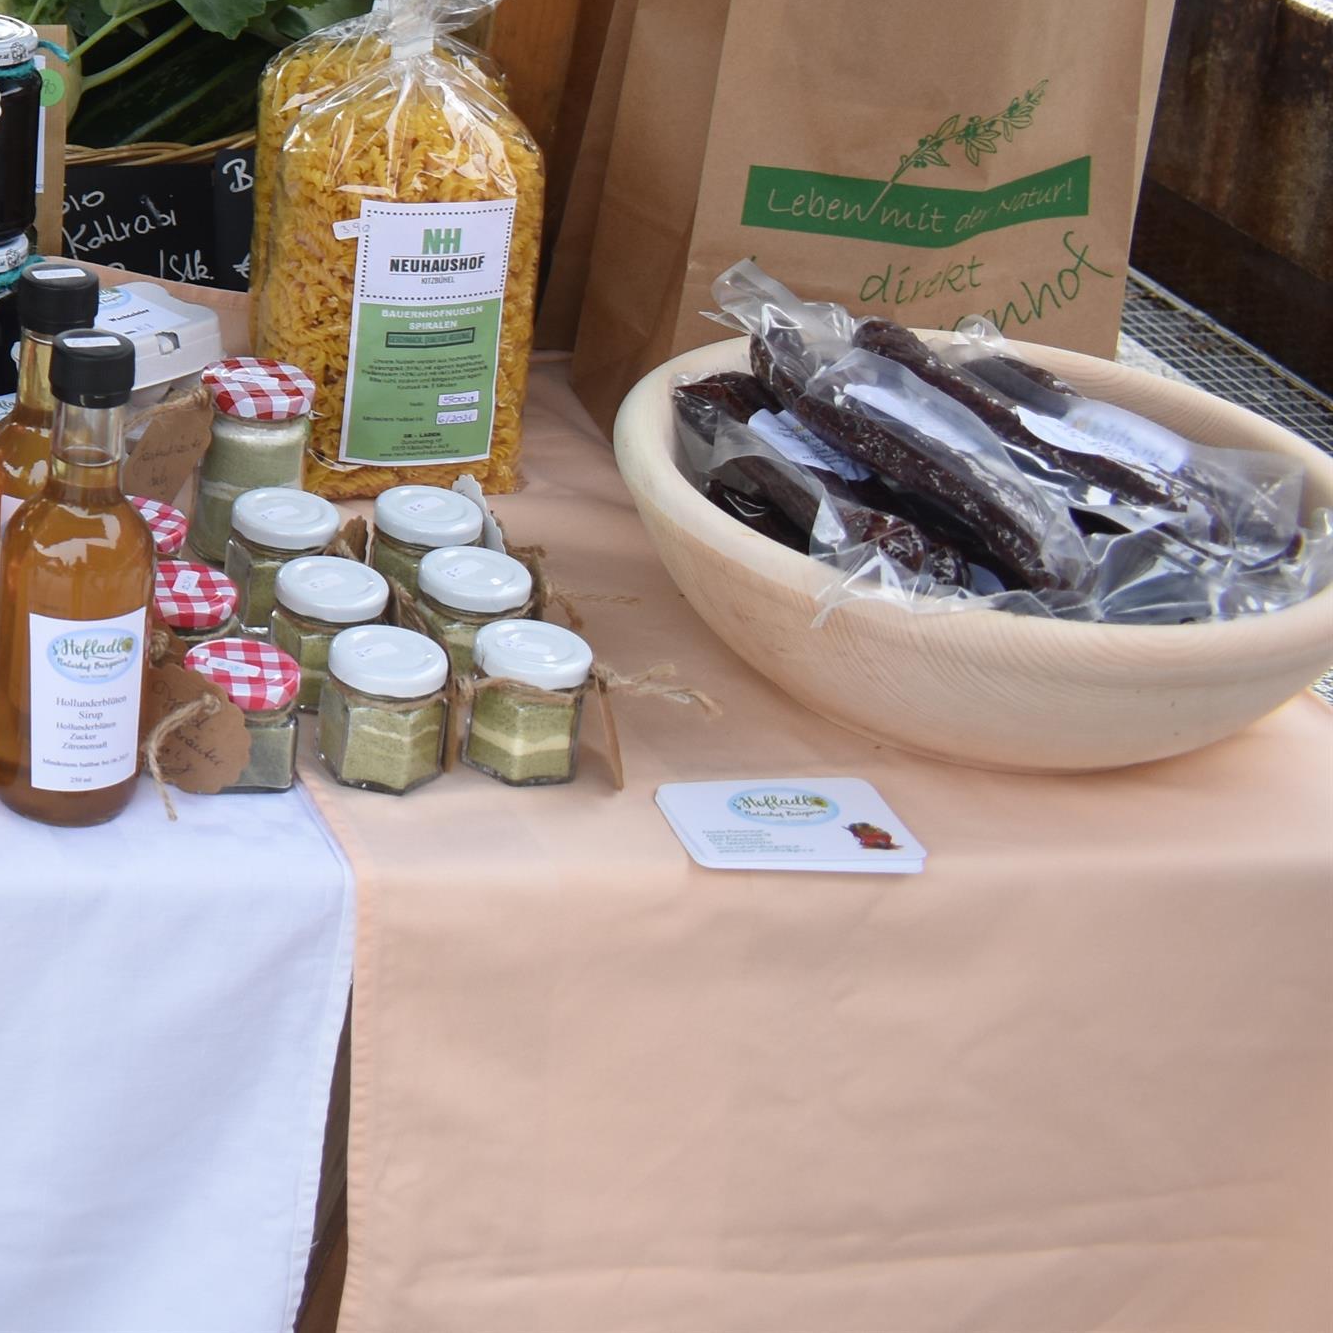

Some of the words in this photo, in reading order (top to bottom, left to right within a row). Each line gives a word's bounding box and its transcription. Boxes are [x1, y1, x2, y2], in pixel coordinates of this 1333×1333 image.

[767, 187, 871, 222] Leben
[880, 202, 946, 234] mit
[953, 204, 993, 233] der
[998, 178, 1074, 212] Natur!
[390, 255, 484, 274] NEUHAUSHOF
[858, 255, 985, 305] direkt
[408, 320, 458, 330] SPIRALEN
[78, 710, 103, 722] Sirup
